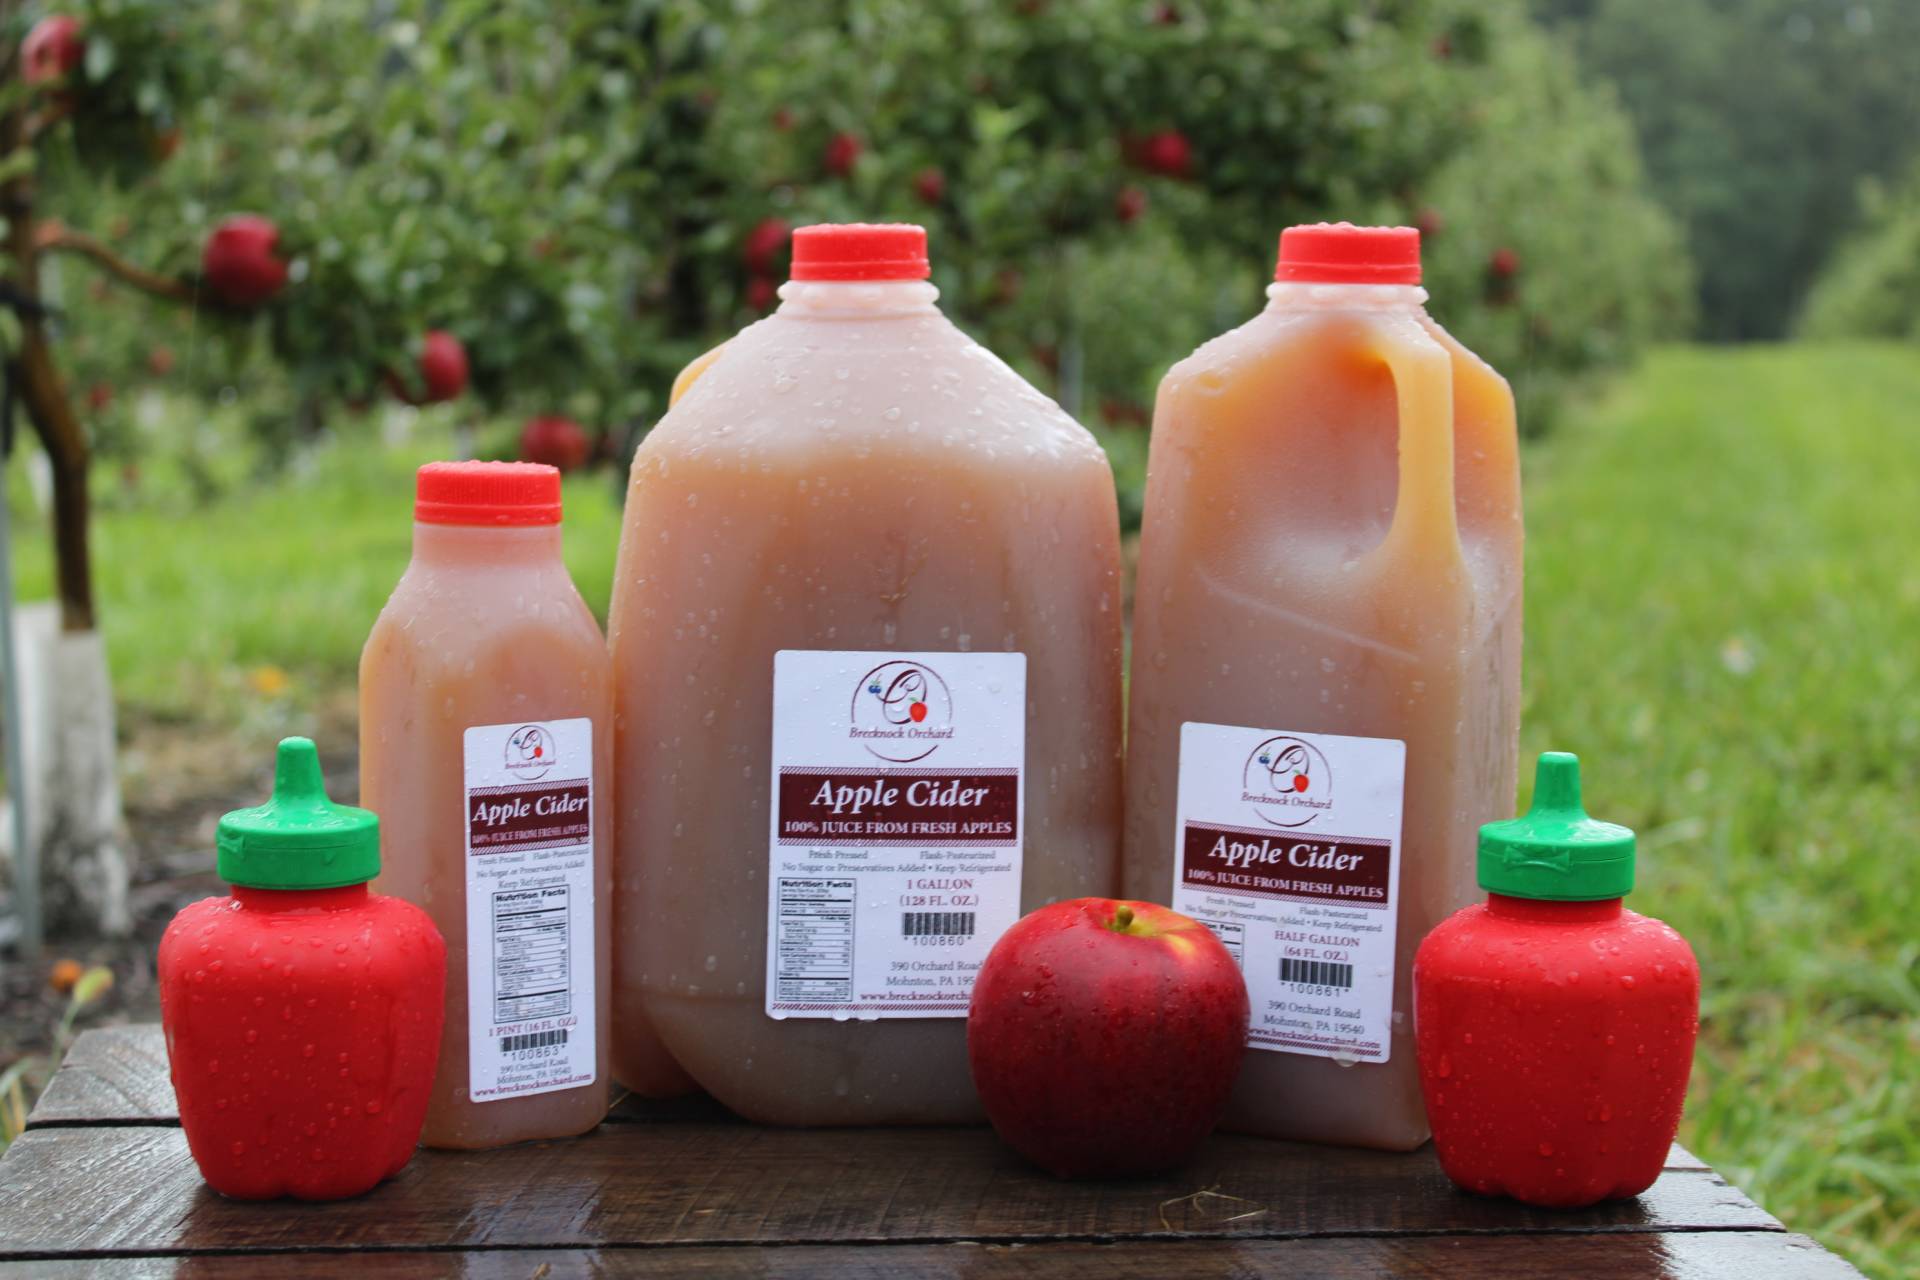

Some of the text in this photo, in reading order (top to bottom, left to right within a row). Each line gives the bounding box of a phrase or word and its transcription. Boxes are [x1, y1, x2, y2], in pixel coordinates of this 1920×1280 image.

[849, 726, 953, 739] Brecknock Orchard
[810, 780, 989, 814] Apple Cider
[1241, 792, 1332, 809] Brecknock Orchard
[472, 794, 588, 826] Apple Cider
[785, 821, 1012, 834] 100% JUICE FROM FRESH APPLES
[1208, 835, 1364, 872] Apple Cider
[782, 863, 1011, 875] No Sugar or Preservatives Added Keep Refrigerated
[907, 878, 973, 890] 1 GALLON
[1188, 869, 1383, 898] 100% JUICE FROM FRESH APPLES
[542, 889, 566, 897] Facts
[900, 895, 979, 907] (128 FL. OZ.)
[1274, 930, 1360, 947] HALF GALLON
[1284, 946, 1349, 962] (64 FL. OZ.)
[891, 962, 909, 971] 390
[911, 961, 955, 971] Orchard
[886, 976, 976, 987] Mohnton, PA 195
[1267, 1000, 1361, 1019] 390 Orchard Road
[496, 1024, 522, 1037] PINT
[524, 1022, 541, 1034] (16
[542, 1021, 557, 1032] FL.
[1316, 1020, 1330, 1031] PA
[1333, 1023, 1365, 1034] 19540
[536, 1069, 548, 1079] PA
